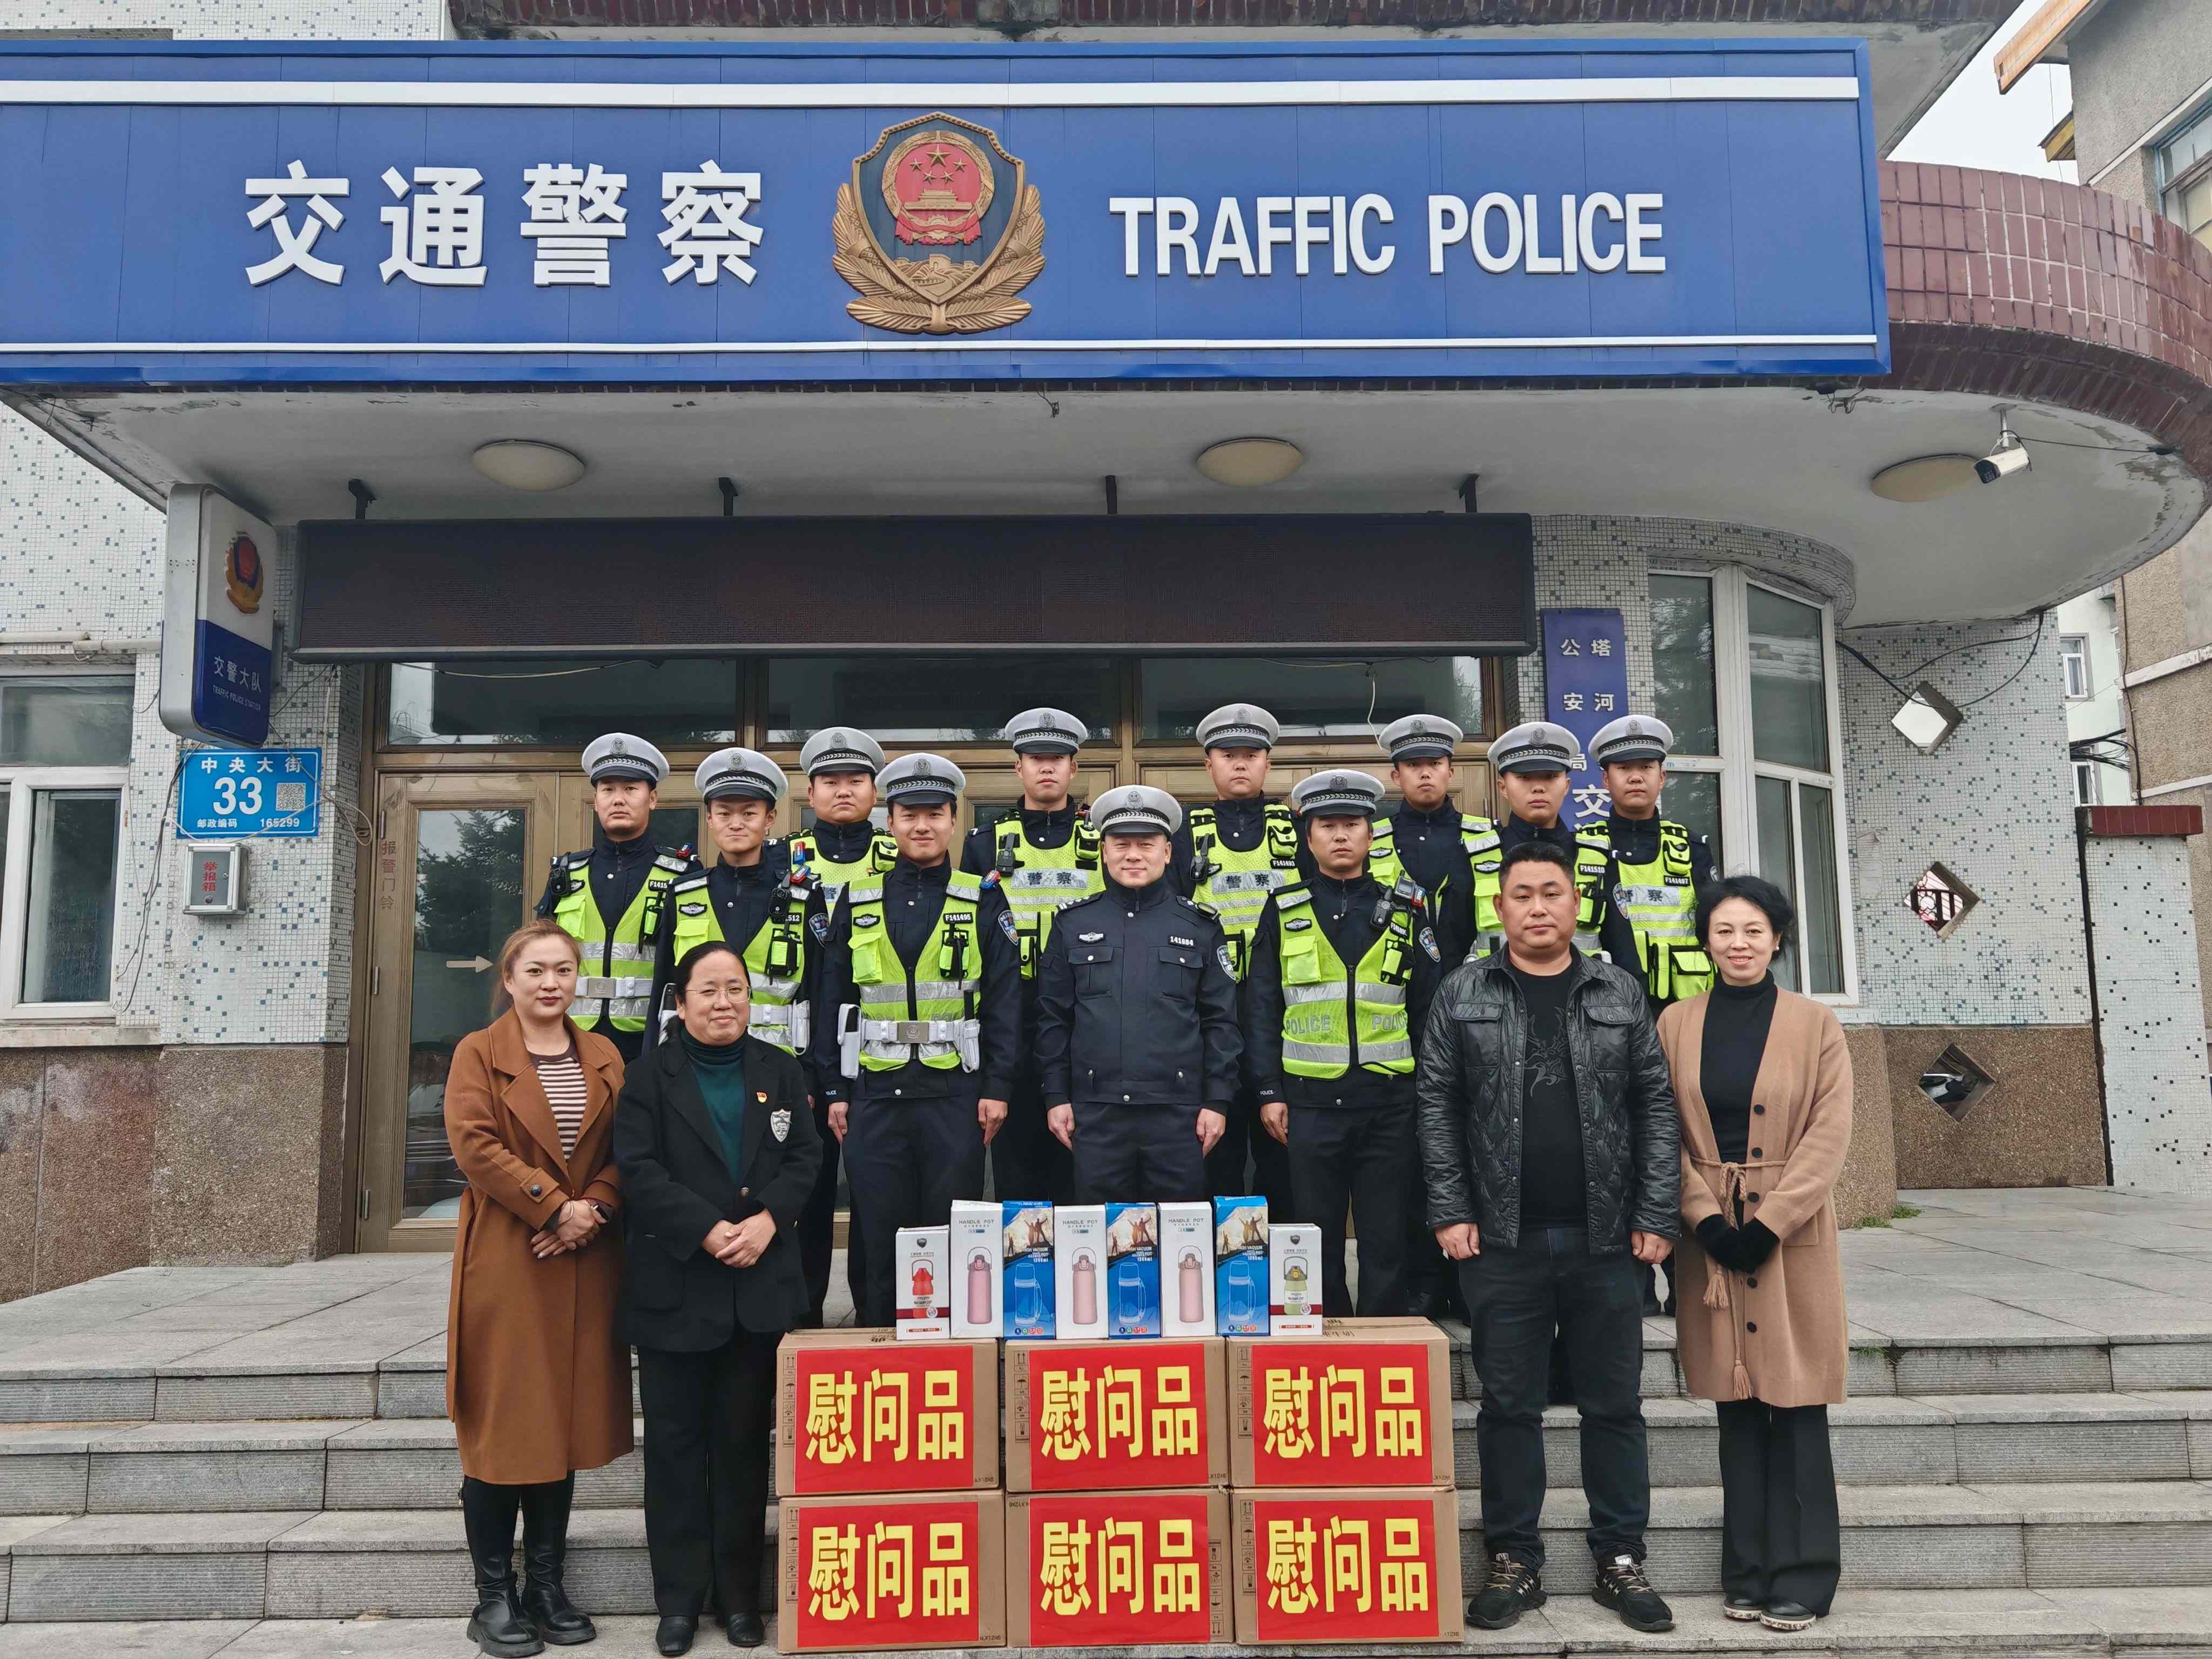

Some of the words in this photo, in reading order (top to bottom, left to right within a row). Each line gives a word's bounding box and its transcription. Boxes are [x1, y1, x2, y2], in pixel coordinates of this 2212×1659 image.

[245, 159, 764, 286] 交通警察
[1109, 192, 1395, 276] TRAFFIC
[1428, 191, 1666, 275] POLICE
[214, 655, 261, 692] 交警大队
[230, 692, 244, 705] POLICE
[201, 757, 302, 774] 中央大街
[213, 777, 262, 815] 33
[1573, 784, 1612, 818] 交
[197, 818, 238, 828] 邮政编码
[260, 818, 300, 828] 165299
[203, 861, 217, 891] 举报箱
[1028, 872, 1071, 885] 警察
[1226, 874, 1269, 889] 警察
[1286, 1015, 1331, 1035] POLICE
[805, 1368, 964, 1464] 慰问品
[1040, 1365, 1198, 1460] 慰问品
[1263, 1364, 1422, 1458] 慰问品
[808, 1521, 969, 1620] 慰问品
[1040, 1516, 1201, 1616] 慰问品
[1266, 1515, 1428, 1614] 慰问品
